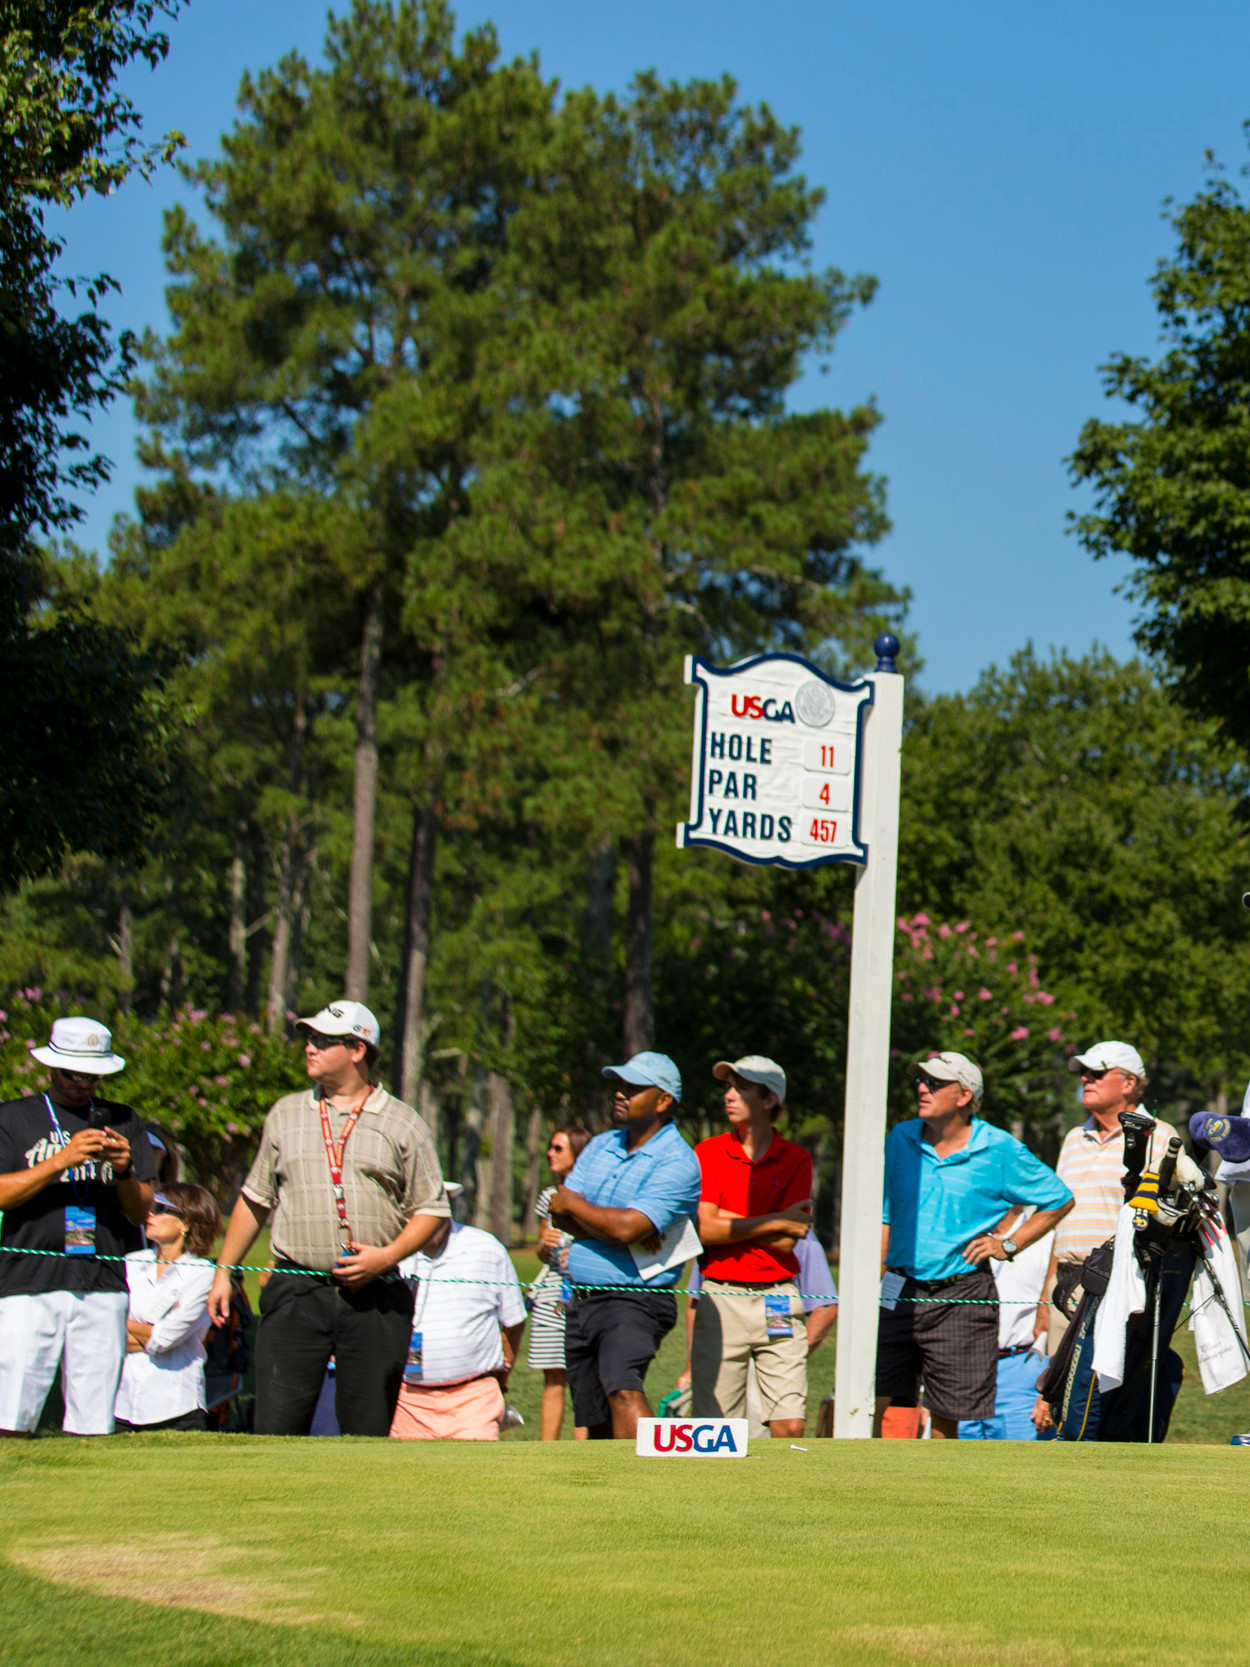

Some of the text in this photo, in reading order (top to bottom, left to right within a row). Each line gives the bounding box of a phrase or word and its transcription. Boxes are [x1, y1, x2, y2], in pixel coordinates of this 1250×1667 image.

[731, 694, 795, 724] USGA
[710, 732, 834, 768] HOLE 11
[708, 769, 830, 805] PAR 4
[708, 808, 837, 843] YARDS 457
[653, 1424, 738, 1453] USGA
